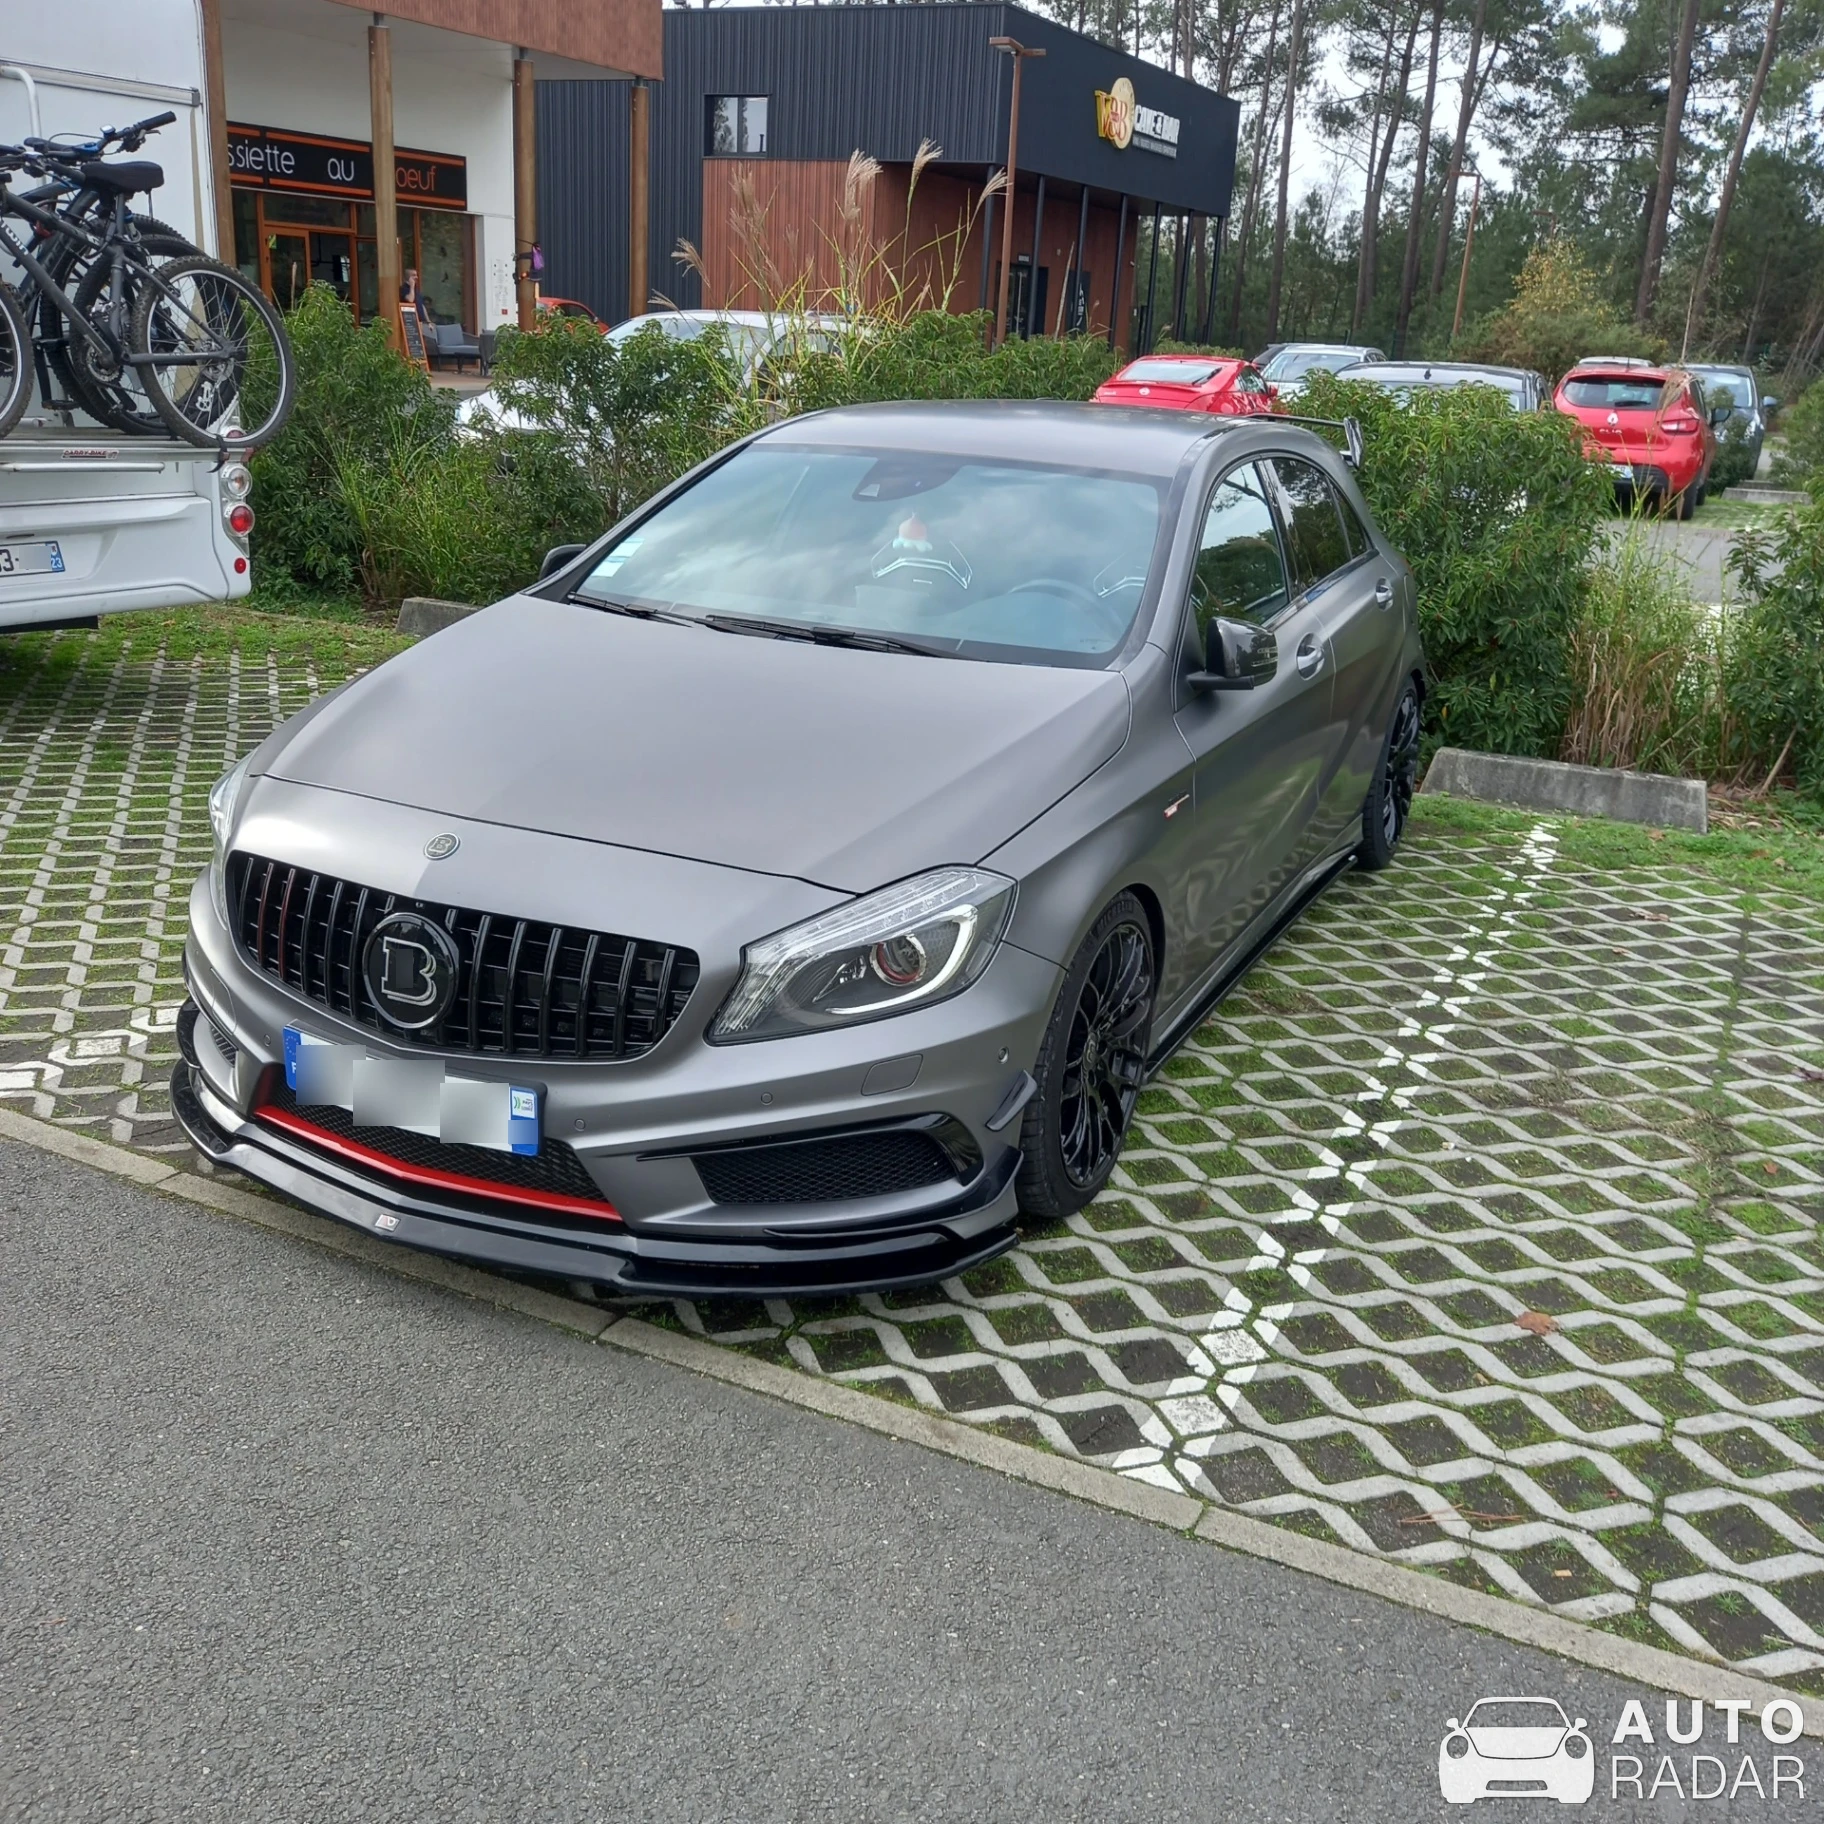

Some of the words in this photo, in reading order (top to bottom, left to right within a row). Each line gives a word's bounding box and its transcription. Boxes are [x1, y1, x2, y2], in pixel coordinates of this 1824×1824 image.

[327, 158, 355, 181] au
[51, 557, 63, 568] 23
[382, 936, 437, 1006] B
